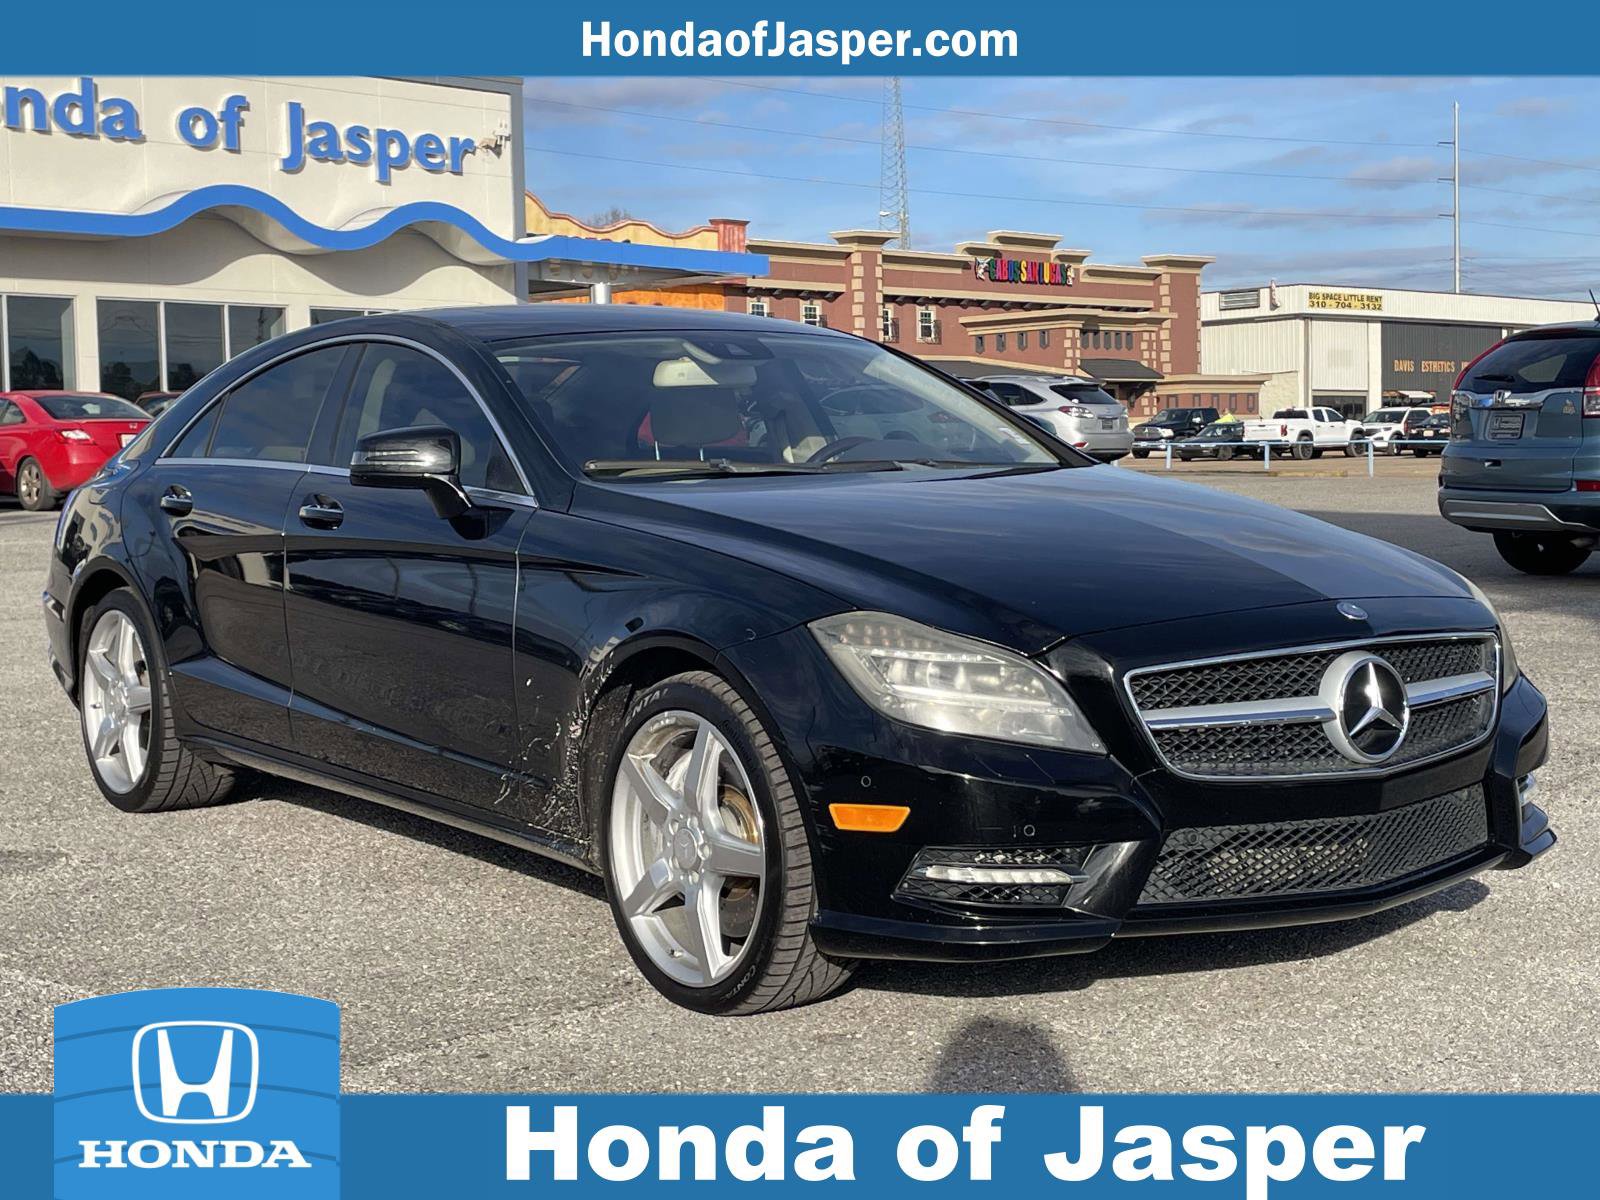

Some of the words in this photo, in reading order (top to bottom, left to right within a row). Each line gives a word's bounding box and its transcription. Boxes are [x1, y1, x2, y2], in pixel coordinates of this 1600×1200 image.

[177, 94, 247, 150] of
[279, 101, 475, 182] Jasper
[1308, 292, 1320, 300] BIG
[1322, 292, 1342, 301] SPACE
[1344, 294, 1364, 302] LITTLE
[1366, 295, 1383, 303] RENT
[1335, 301, 1352, 309] 704
[1394, 360, 1415, 372] DAVIS
[1421, 361, 1455, 372] ESTHETICS
